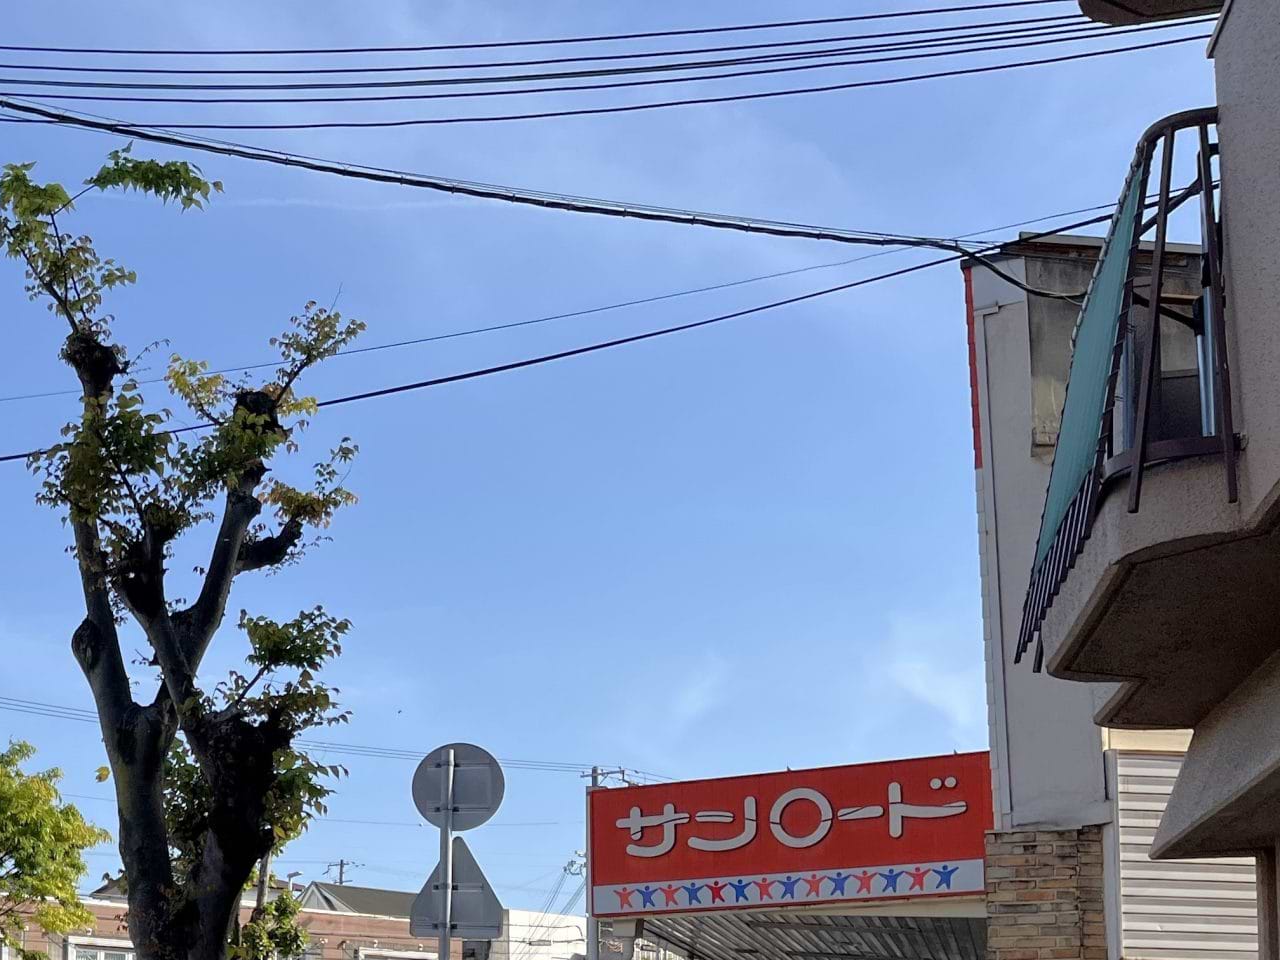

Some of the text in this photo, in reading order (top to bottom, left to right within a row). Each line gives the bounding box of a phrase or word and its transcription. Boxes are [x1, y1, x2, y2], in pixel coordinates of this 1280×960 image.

[615, 775, 968, 858] サンロード
